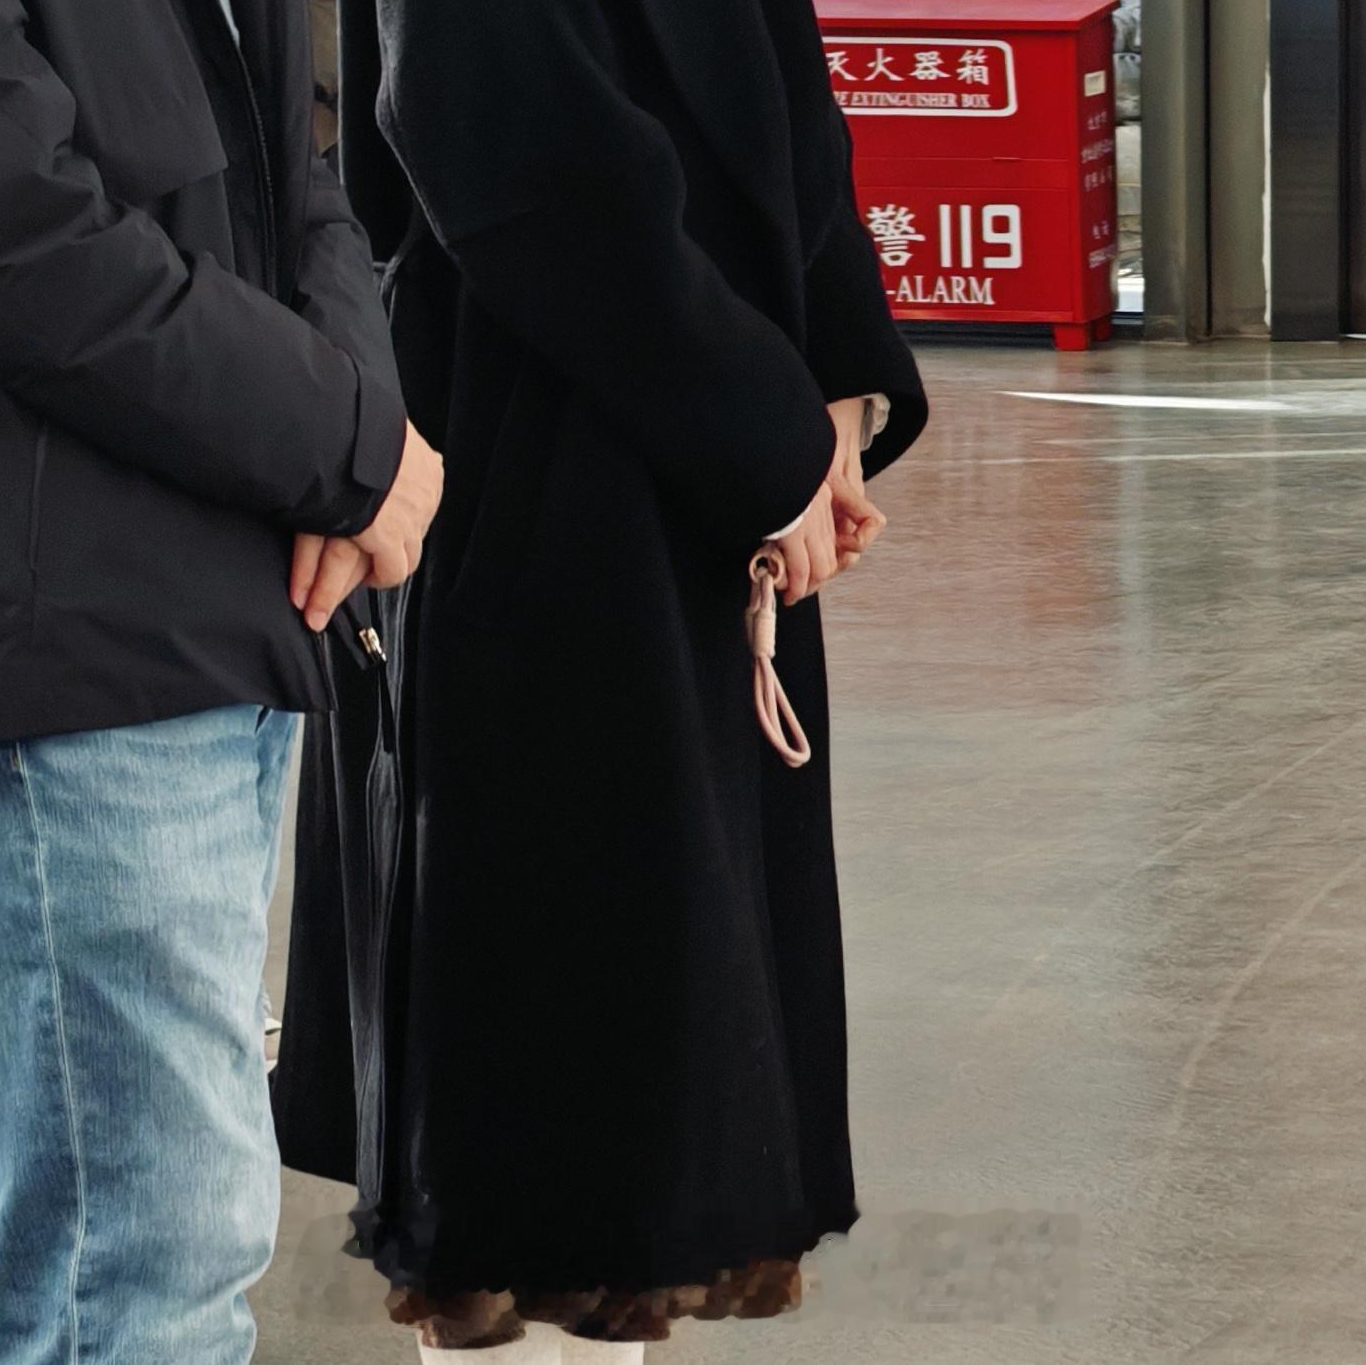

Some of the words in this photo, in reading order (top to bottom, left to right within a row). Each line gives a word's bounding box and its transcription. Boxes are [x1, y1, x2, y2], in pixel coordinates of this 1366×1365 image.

[826, 48, 990, 85] 灭火器箱
[851, 91, 958, 107] EXTINGUISHER
[961, 93, 991, 108] BOX
